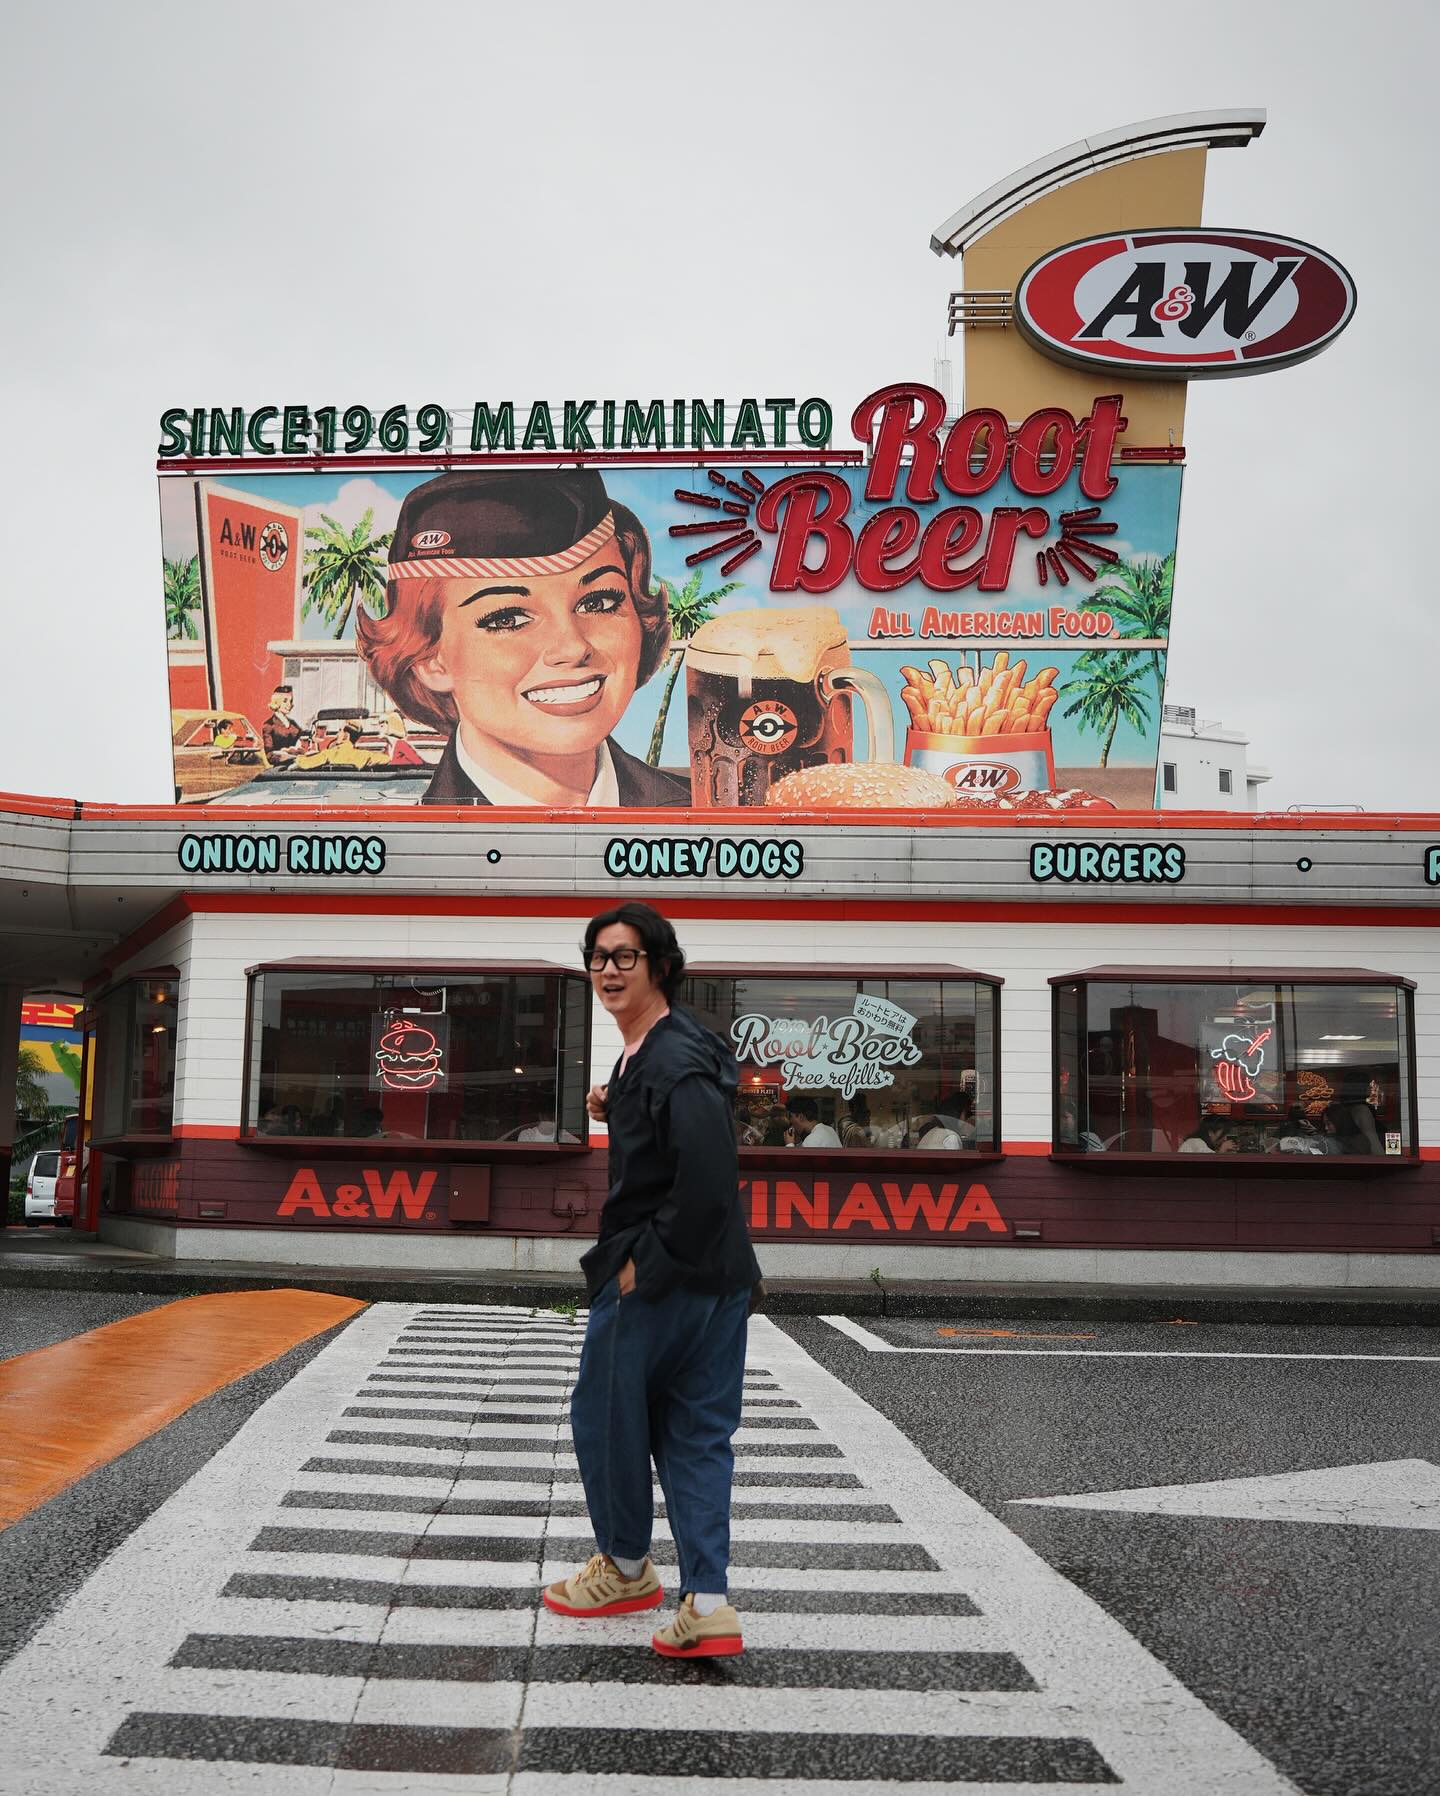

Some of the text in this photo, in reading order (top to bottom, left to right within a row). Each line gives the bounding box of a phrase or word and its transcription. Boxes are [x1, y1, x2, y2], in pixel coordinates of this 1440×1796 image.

[1077, 260, 1304, 340] A&W
[470, 397, 833, 451] MAKIMINATO
[851, 382, 1128, 503] Root
[756, 471, 1050, 593] Beer
[747, 738, 790, 752] ROOT BEER
[179, 834, 386, 874] ONION RINGS
[604, 838, 804, 878] CONEY DOGS
[1030, 843, 1186, 882] BURGERS
[733, 1015, 919, 1065] Root Beer
[857, 1006, 904, 1034] おかわり無料
[783, 1061, 882, 1096] Free refills
[276, 1168, 438, 1219] A&W
[738, 1179, 1008, 1232] INAWA
